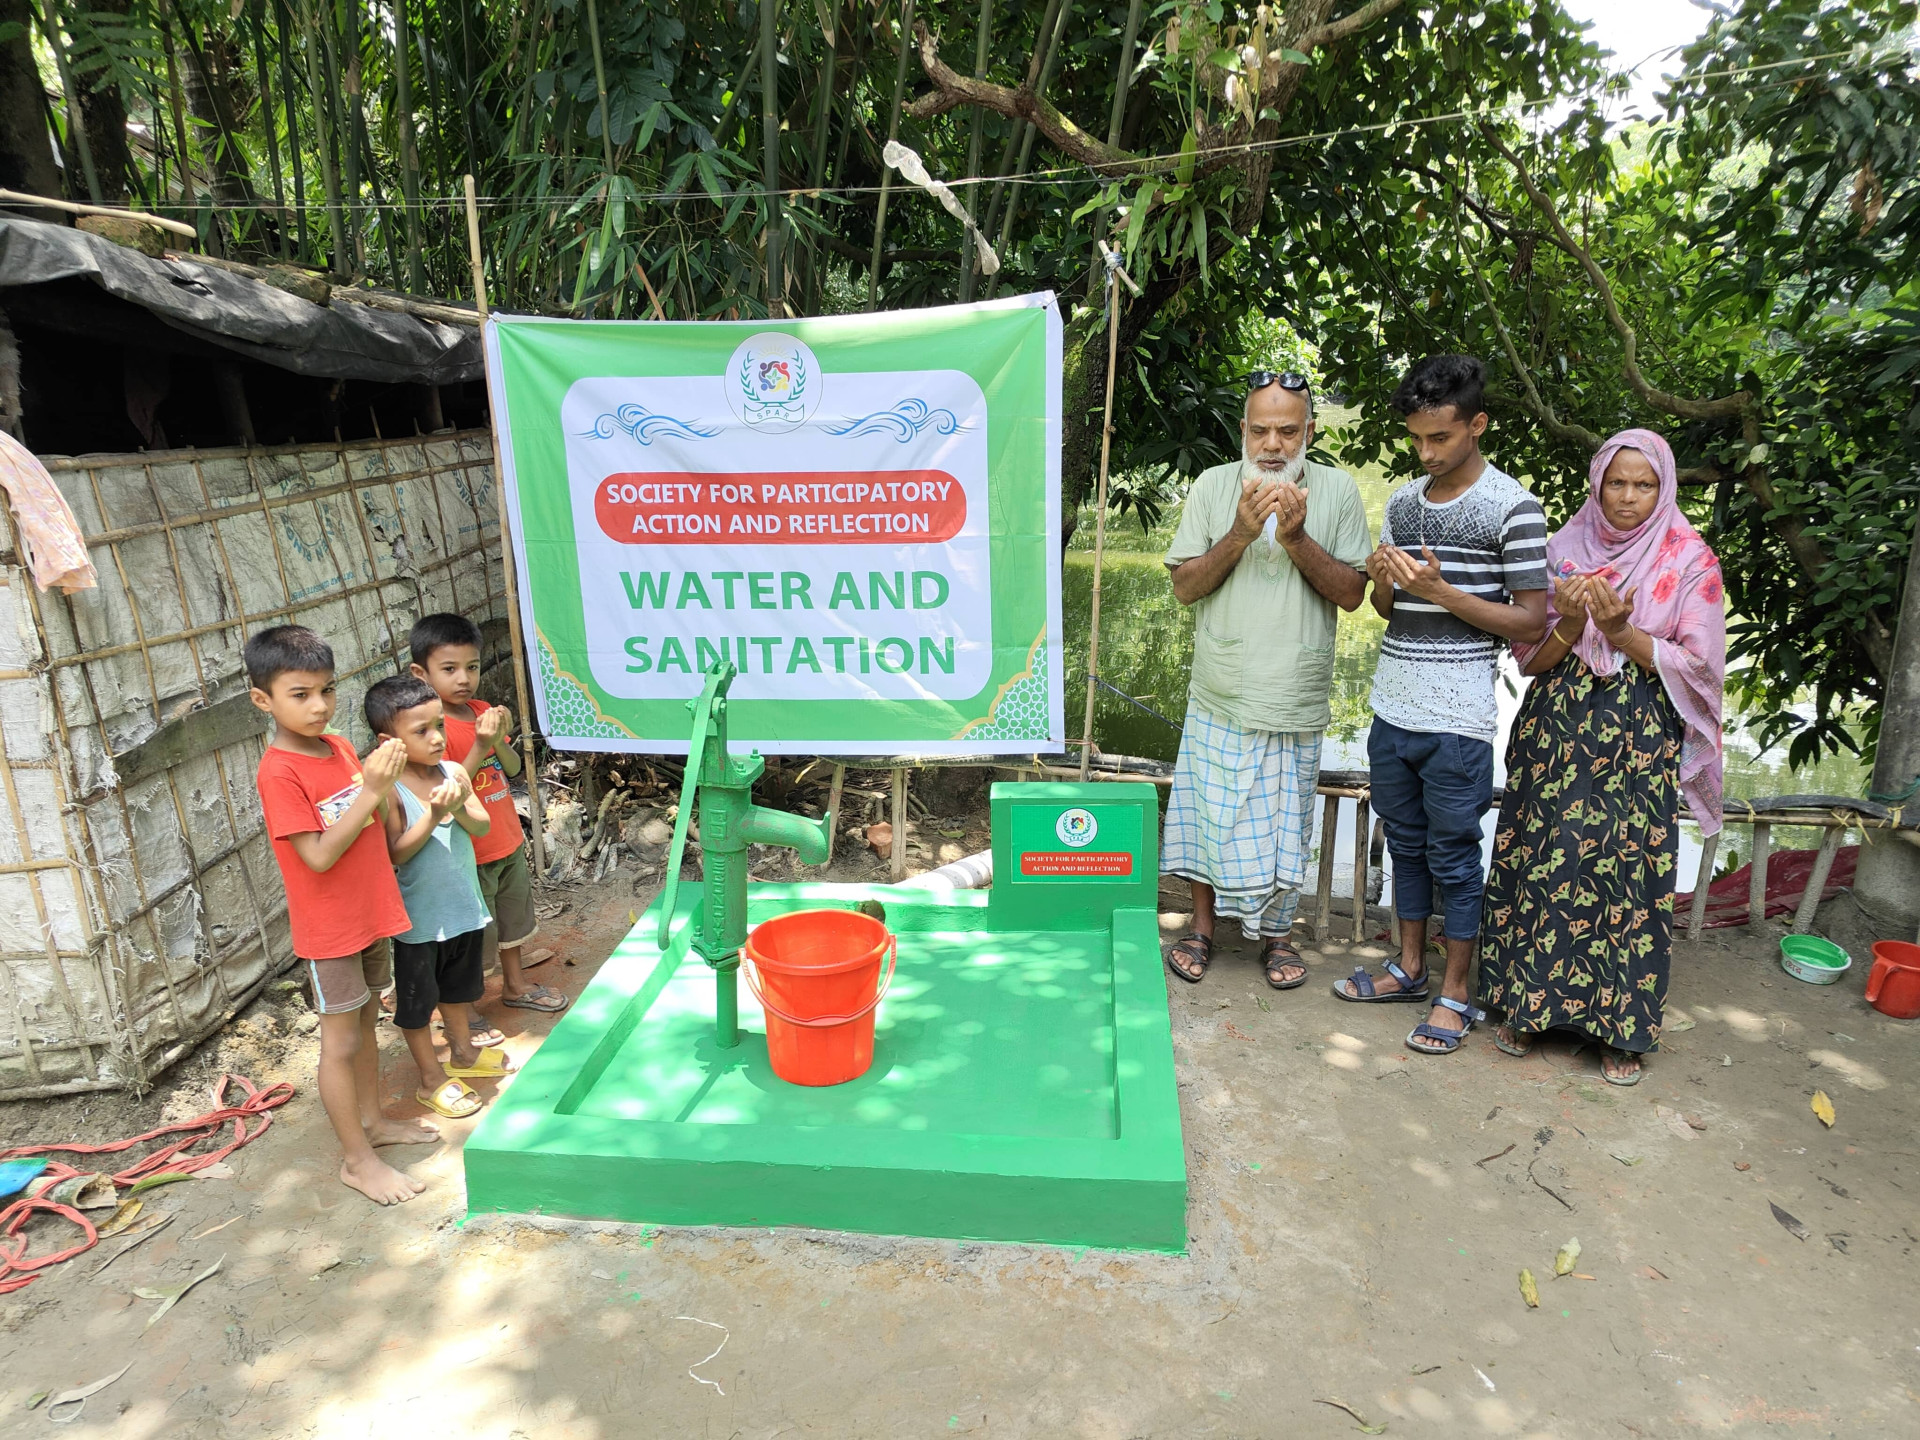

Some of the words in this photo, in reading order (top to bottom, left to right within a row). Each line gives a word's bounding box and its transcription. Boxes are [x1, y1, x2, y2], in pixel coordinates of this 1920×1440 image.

[757, 409, 790, 420] SPAR
[607, 483, 702, 504] SOCIETY
[710, 483, 756, 504] FOR
[762, 481, 952, 504] PARTICIPATORY
[632, 514, 721, 534] ACTION
[729, 514, 781, 534] AND
[789, 513, 930, 534] REFLECTION
[619, 571, 814, 610] WATER
[828, 570, 950, 610] AND
[624, 636, 955, 675] SANITATION
[1024, 855, 1053, 863] SOCIETY
[1055, 855, 1070, 863] FOR
[1071, 855, 1128, 863] PARTICIPATORY
